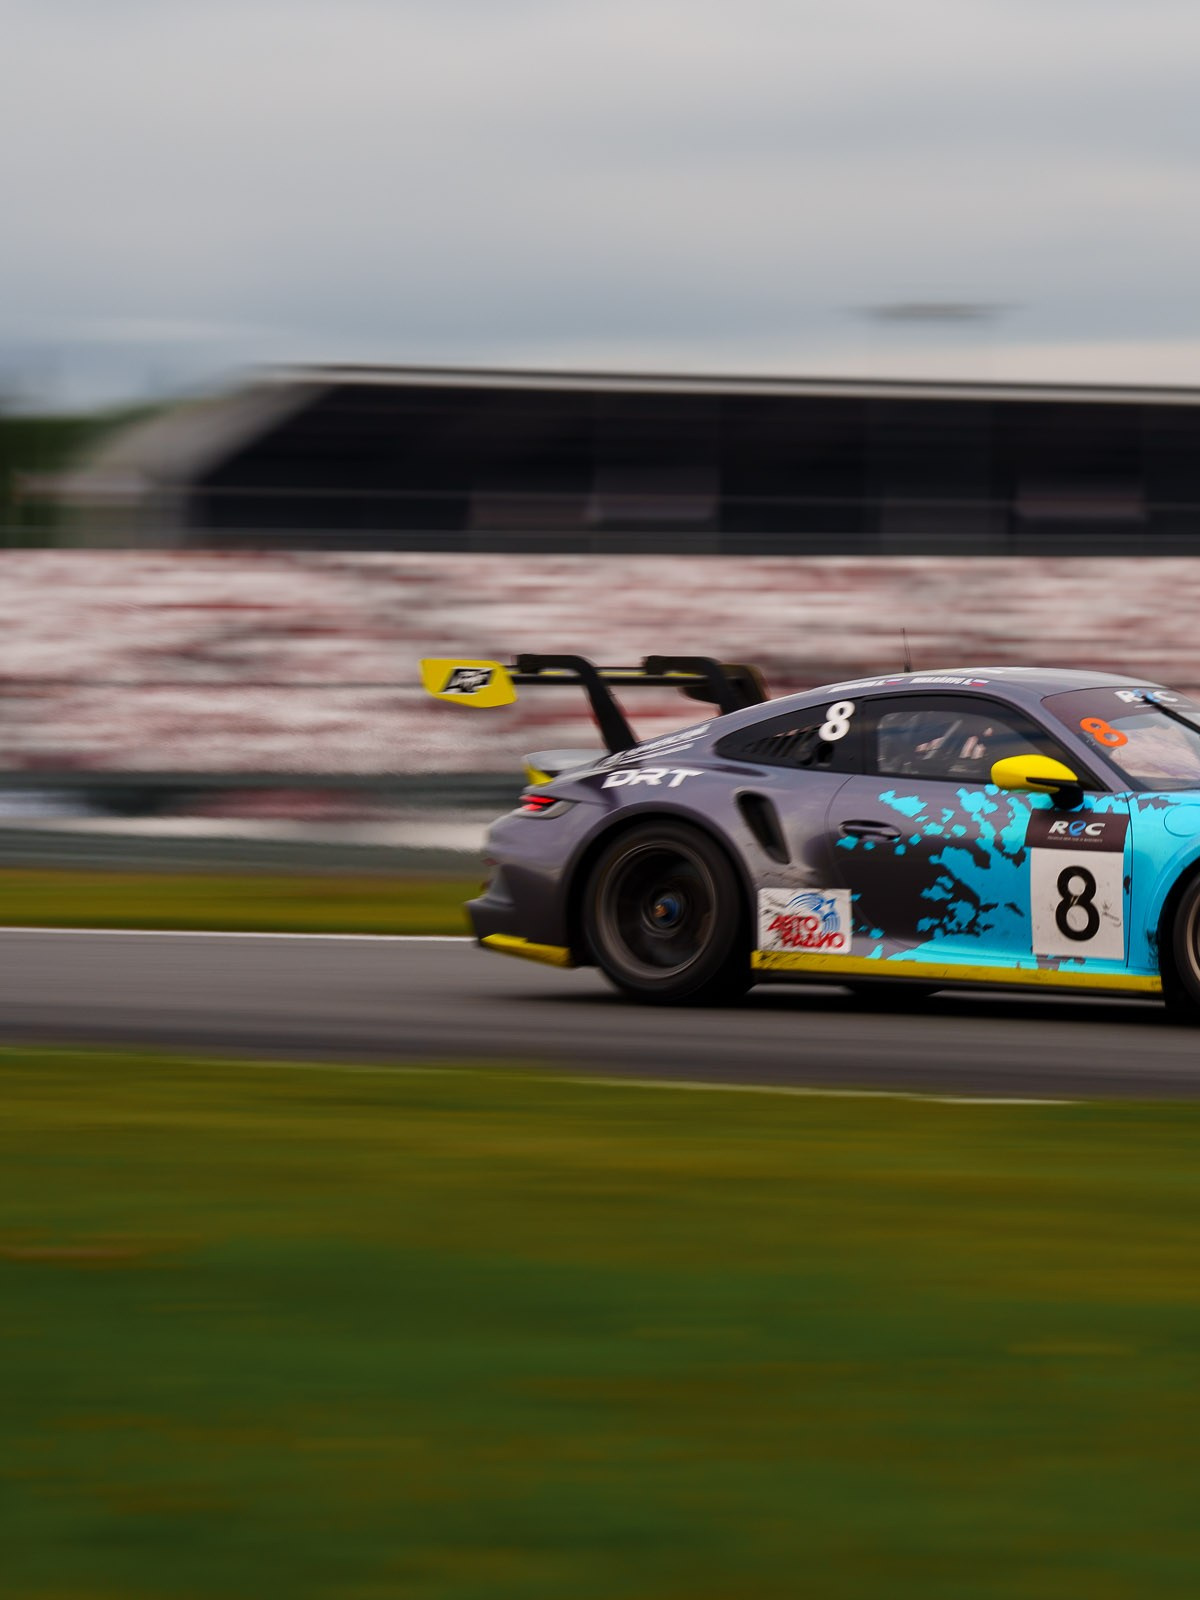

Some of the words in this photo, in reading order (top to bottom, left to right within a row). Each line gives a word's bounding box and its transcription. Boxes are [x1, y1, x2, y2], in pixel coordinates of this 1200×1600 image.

[820, 701, 855, 742] 8
[1080, 717, 1128, 747] 8
[600, 767, 704, 789] DRT
[1056, 865, 1100, 942] 8
